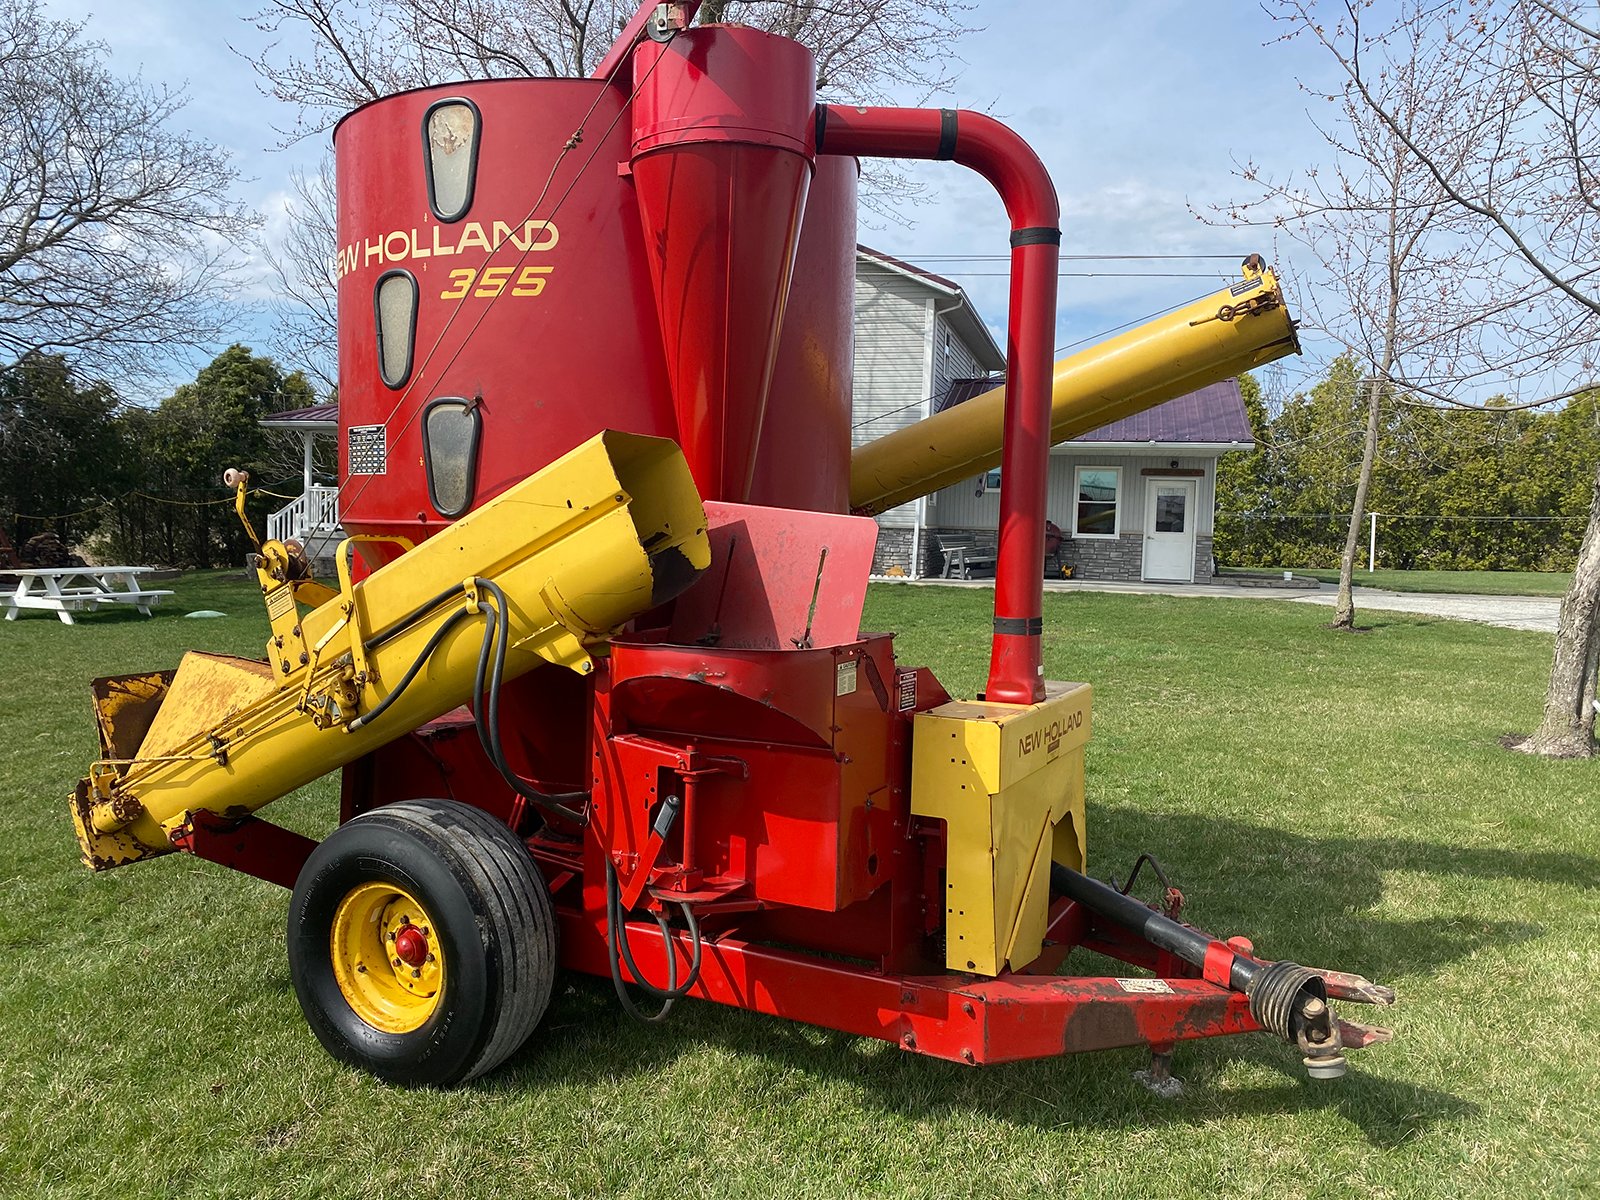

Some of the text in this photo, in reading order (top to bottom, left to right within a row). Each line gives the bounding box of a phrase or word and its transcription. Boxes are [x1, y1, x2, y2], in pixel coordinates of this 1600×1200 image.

[337, 219, 560, 280] EW HOLLAND
[440, 266, 555, 300] 355
[1018, 729, 1042, 758] NEW
[1044, 710, 1083, 745] HOLLAND
